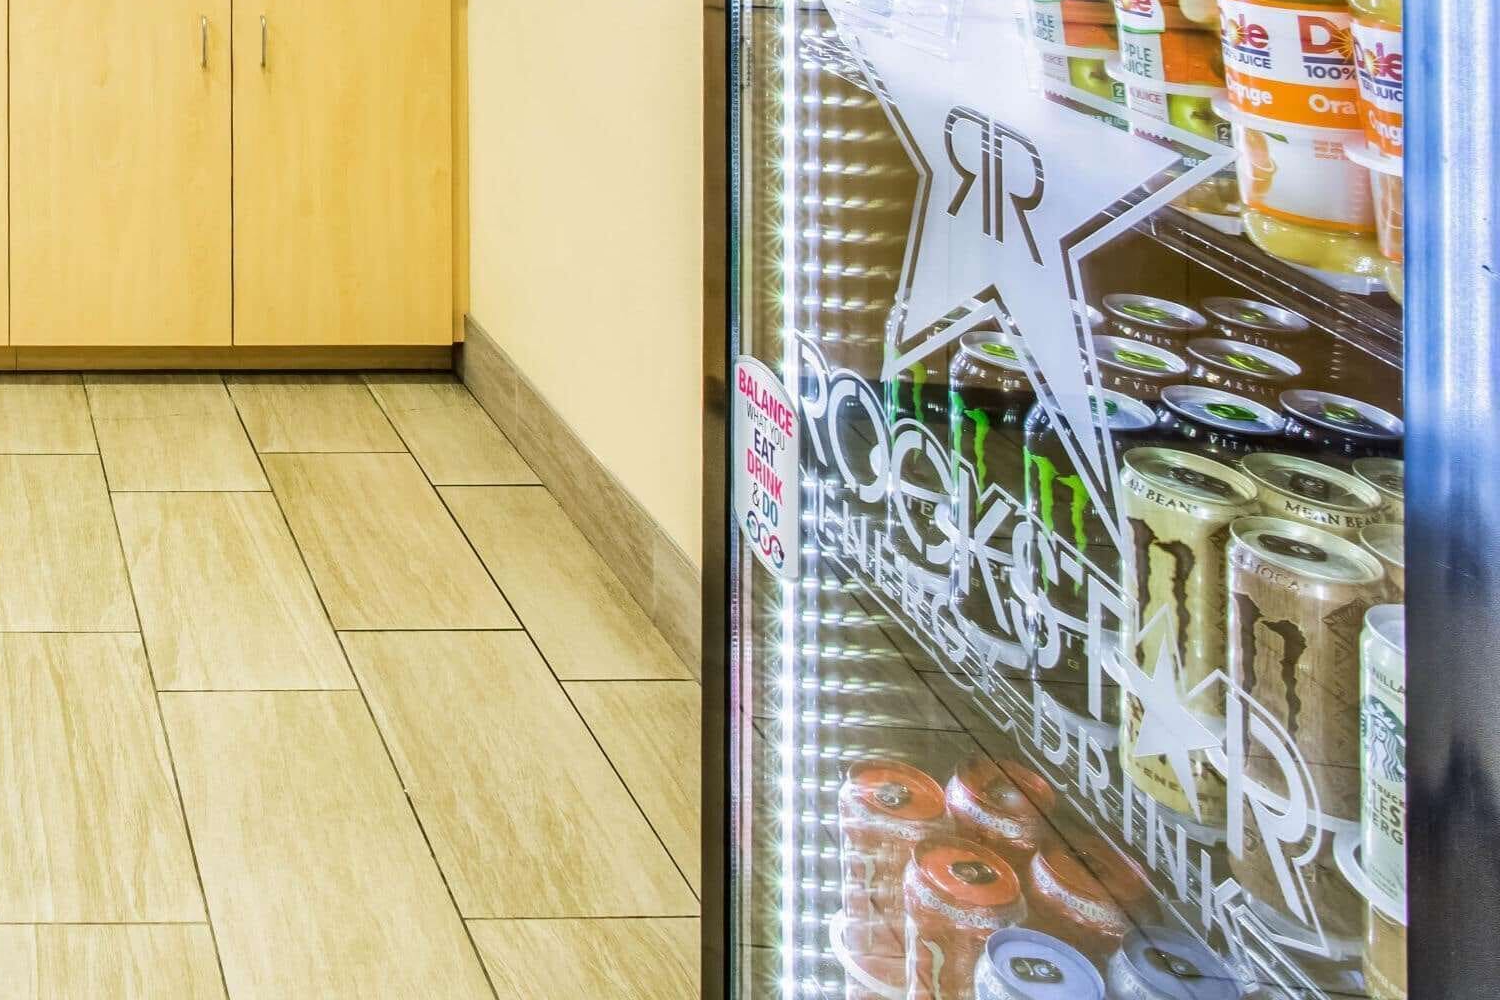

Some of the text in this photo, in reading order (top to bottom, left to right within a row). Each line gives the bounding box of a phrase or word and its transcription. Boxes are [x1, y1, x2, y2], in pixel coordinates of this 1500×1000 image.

[738, 367, 793, 437] BALANCE
[746, 400, 786, 451] WHAT YOU
[754, 429, 775, 468] EAT
[746, 447, 783, 506] DRINK
[751, 483, 779, 528] & DO
[1146, 488, 1193, 515] BEAN
[1284, 499, 1341, 527] MEAN
